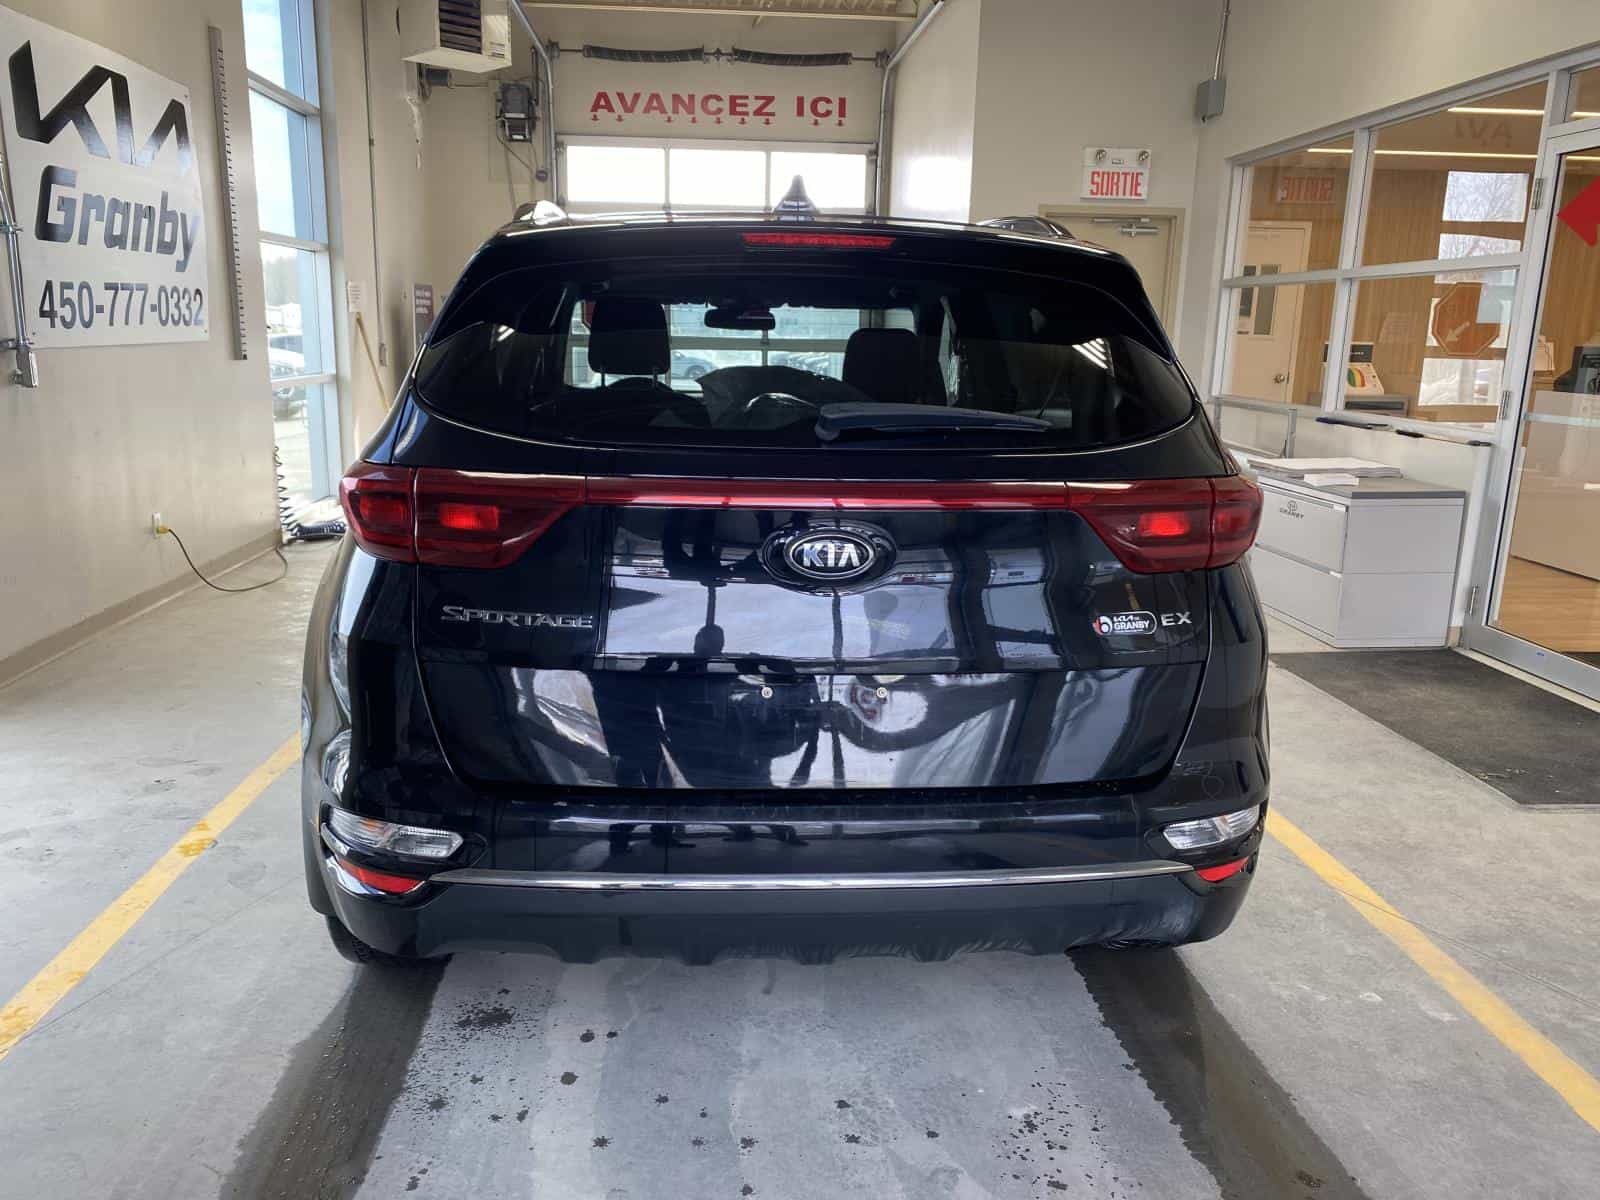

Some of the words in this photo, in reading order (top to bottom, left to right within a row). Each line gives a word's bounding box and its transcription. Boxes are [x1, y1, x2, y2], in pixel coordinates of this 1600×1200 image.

[8, 39, 195, 177] KIA
[590, 91, 776, 117] AVANCEZ
[796, 95, 847, 119] ICI
[1090, 170, 1144, 197] SORTIE
[34, 164, 201, 273] Granby
[39, 279, 205, 330] 450-777-0332
[803, 543, 860, 567] KIA
[440, 605, 593, 629] SPORTAGE
[1113, 620, 1150, 631] GRANBY
[1161, 611, 1193, 627] EX
